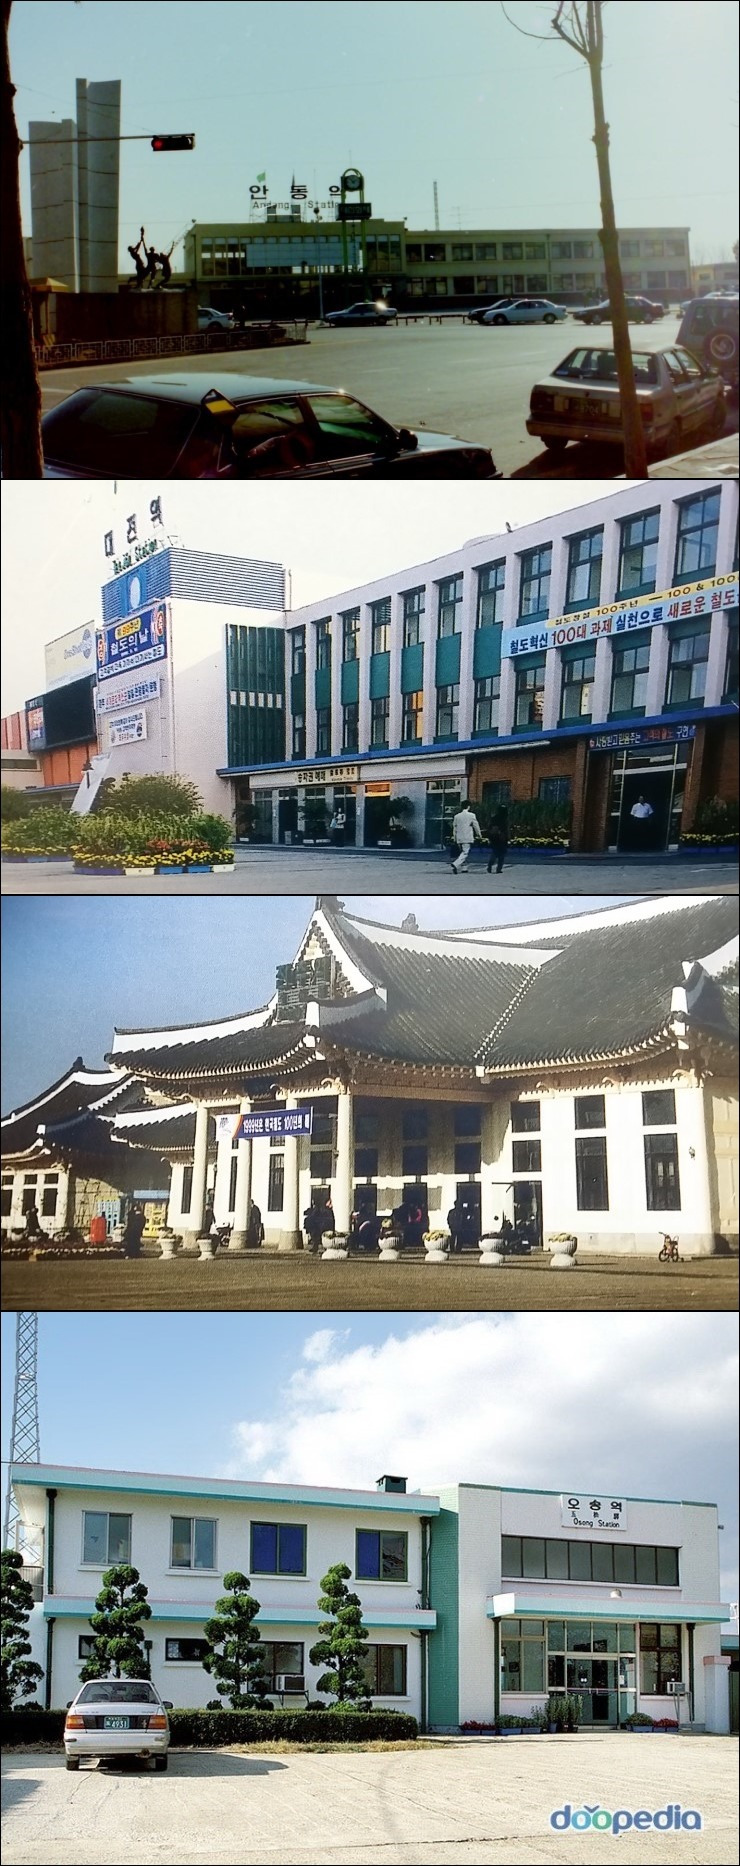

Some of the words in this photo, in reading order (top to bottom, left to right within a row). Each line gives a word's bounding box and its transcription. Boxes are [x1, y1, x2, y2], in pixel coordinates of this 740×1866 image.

[596, 600, 639, 617] 100주년
[668, 586, 691, 599] 100
[696, 582, 705, 592] &
[710, 575, 736, 588] 100
[510, 632, 548, 655] 철도혁신
[551, 622, 586, 646] 100대
[590, 617, 613, 637] 과제
[615, 607, 664, 631] 실천으로
[667, 596, 706, 619] 새로운
[710, 588, 740, 610] 철도
[573, 1517, 594, 1528] Osong
[598, 1519, 620, 1528] Station
[111, 1720, 127, 1729] 4931
